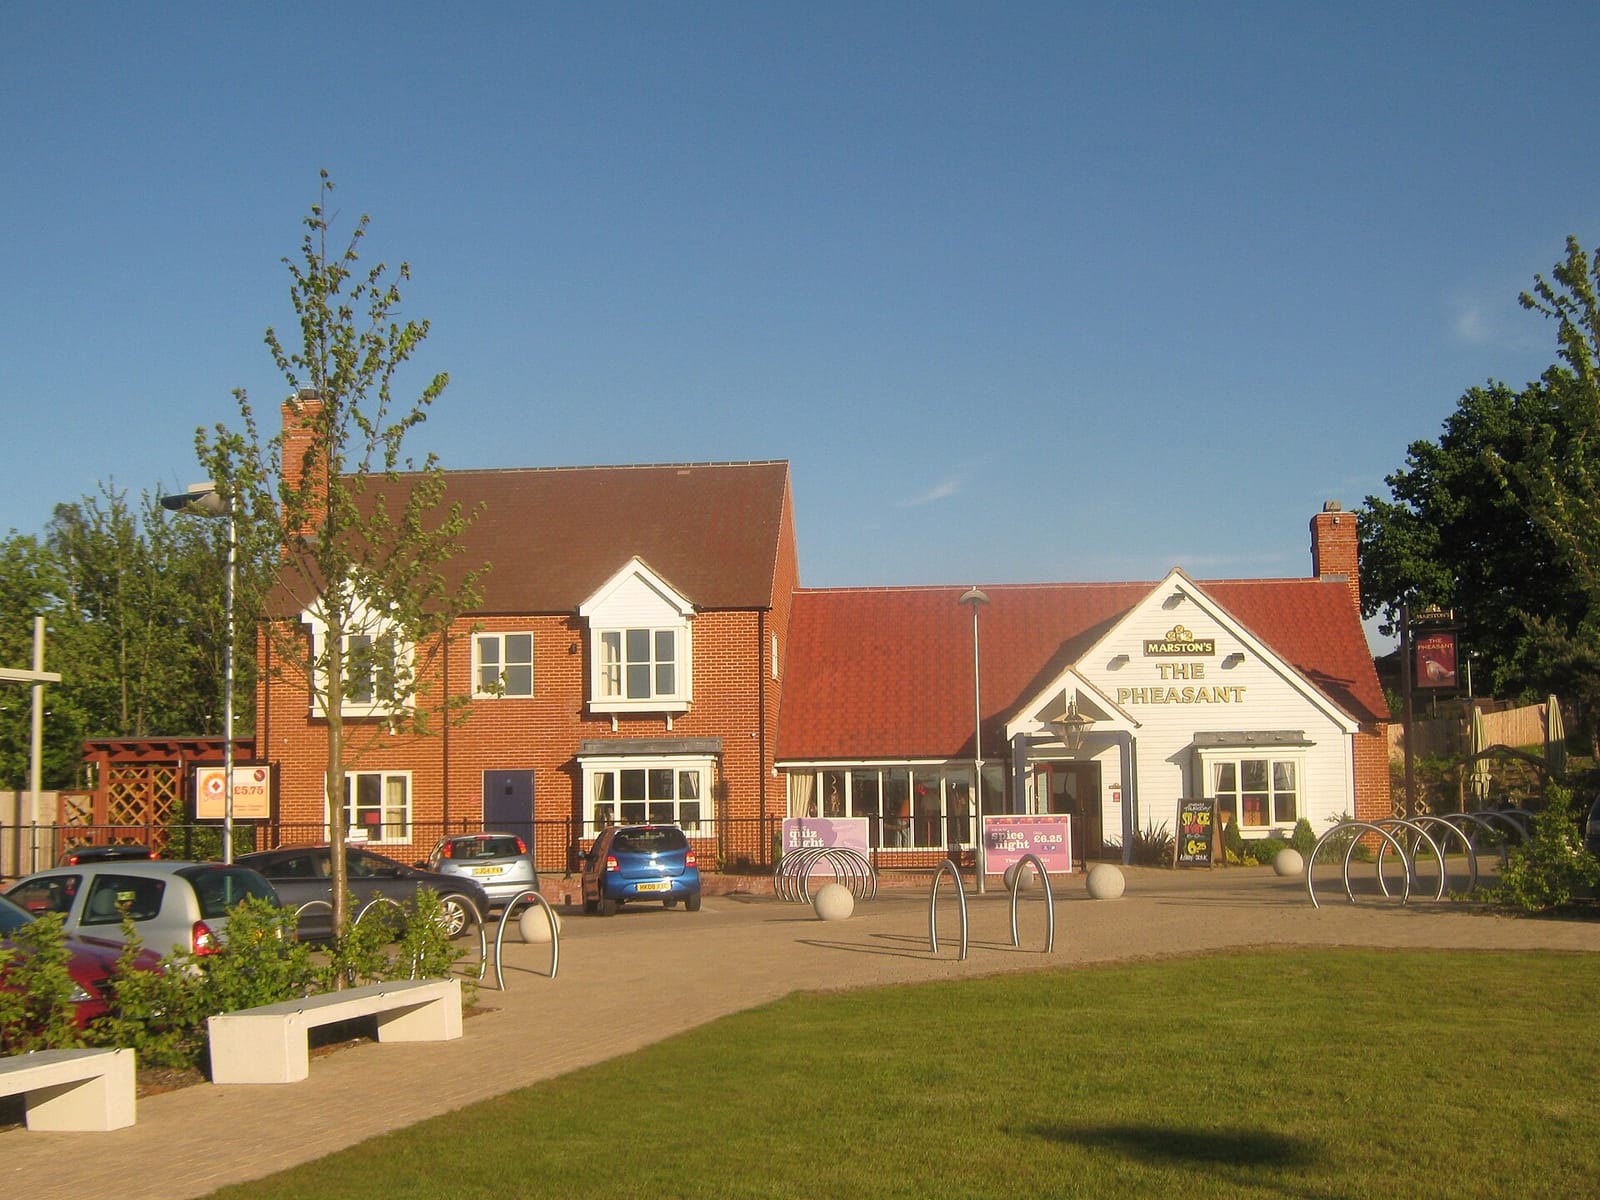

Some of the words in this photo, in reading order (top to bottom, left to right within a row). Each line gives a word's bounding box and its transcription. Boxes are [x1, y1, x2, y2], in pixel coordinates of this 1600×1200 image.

[1148, 643, 1212, 653] MARSTON'S
[1156, 662, 1205, 680] THE
[1117, 686, 1246, 705] PHEASANT
[234, 786, 264, 795] £5.75
[991, 829, 1024, 843] spice
[1033, 834, 1062, 843] £6.25
[994, 839, 1030, 852] night
